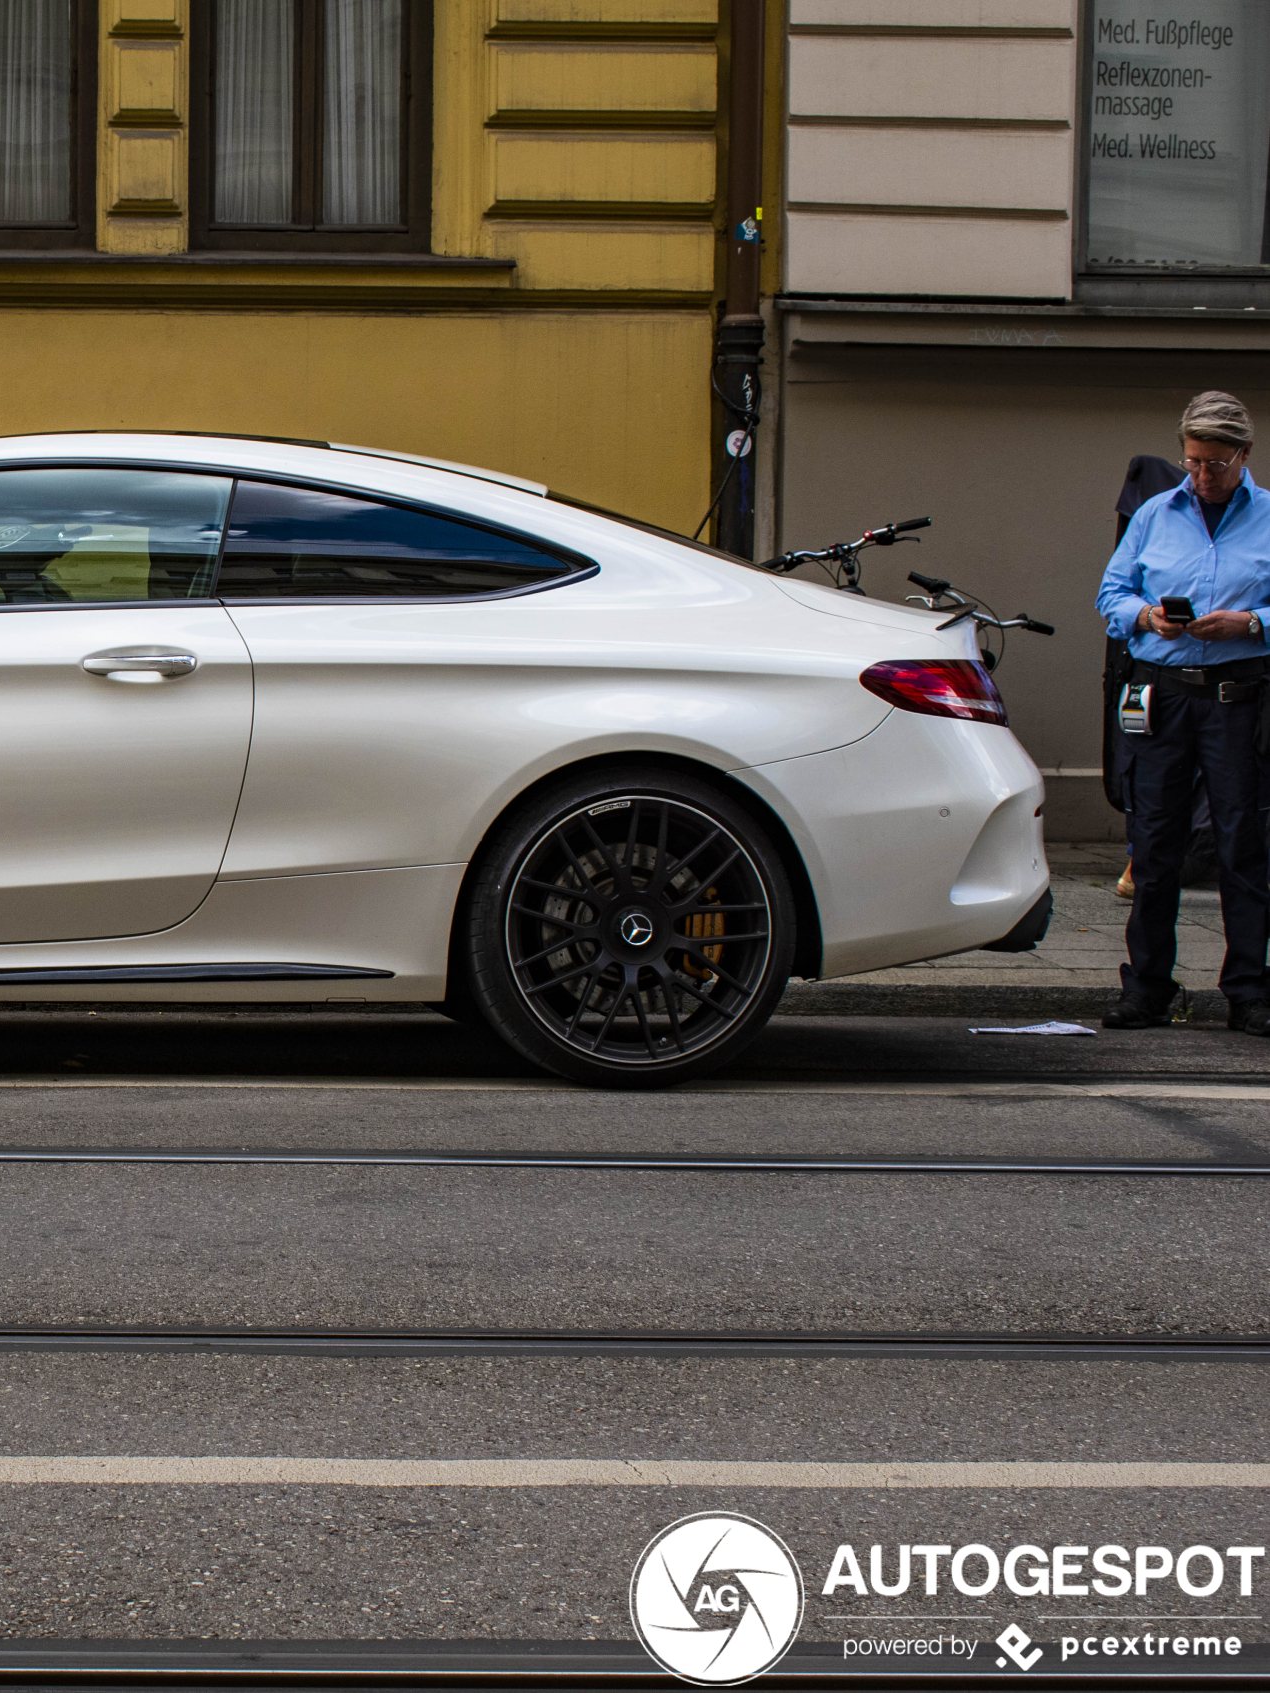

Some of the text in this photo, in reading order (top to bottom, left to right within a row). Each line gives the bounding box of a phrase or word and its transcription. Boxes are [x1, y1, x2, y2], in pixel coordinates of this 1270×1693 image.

[1097, 18, 1233, 50] Med. Fußpflege
[1096, 61, 1212, 88] Reflexzonen-
[1095, 96, 1173, 120] massage
[1092, 133, 1216, 159] Med. Wellness
